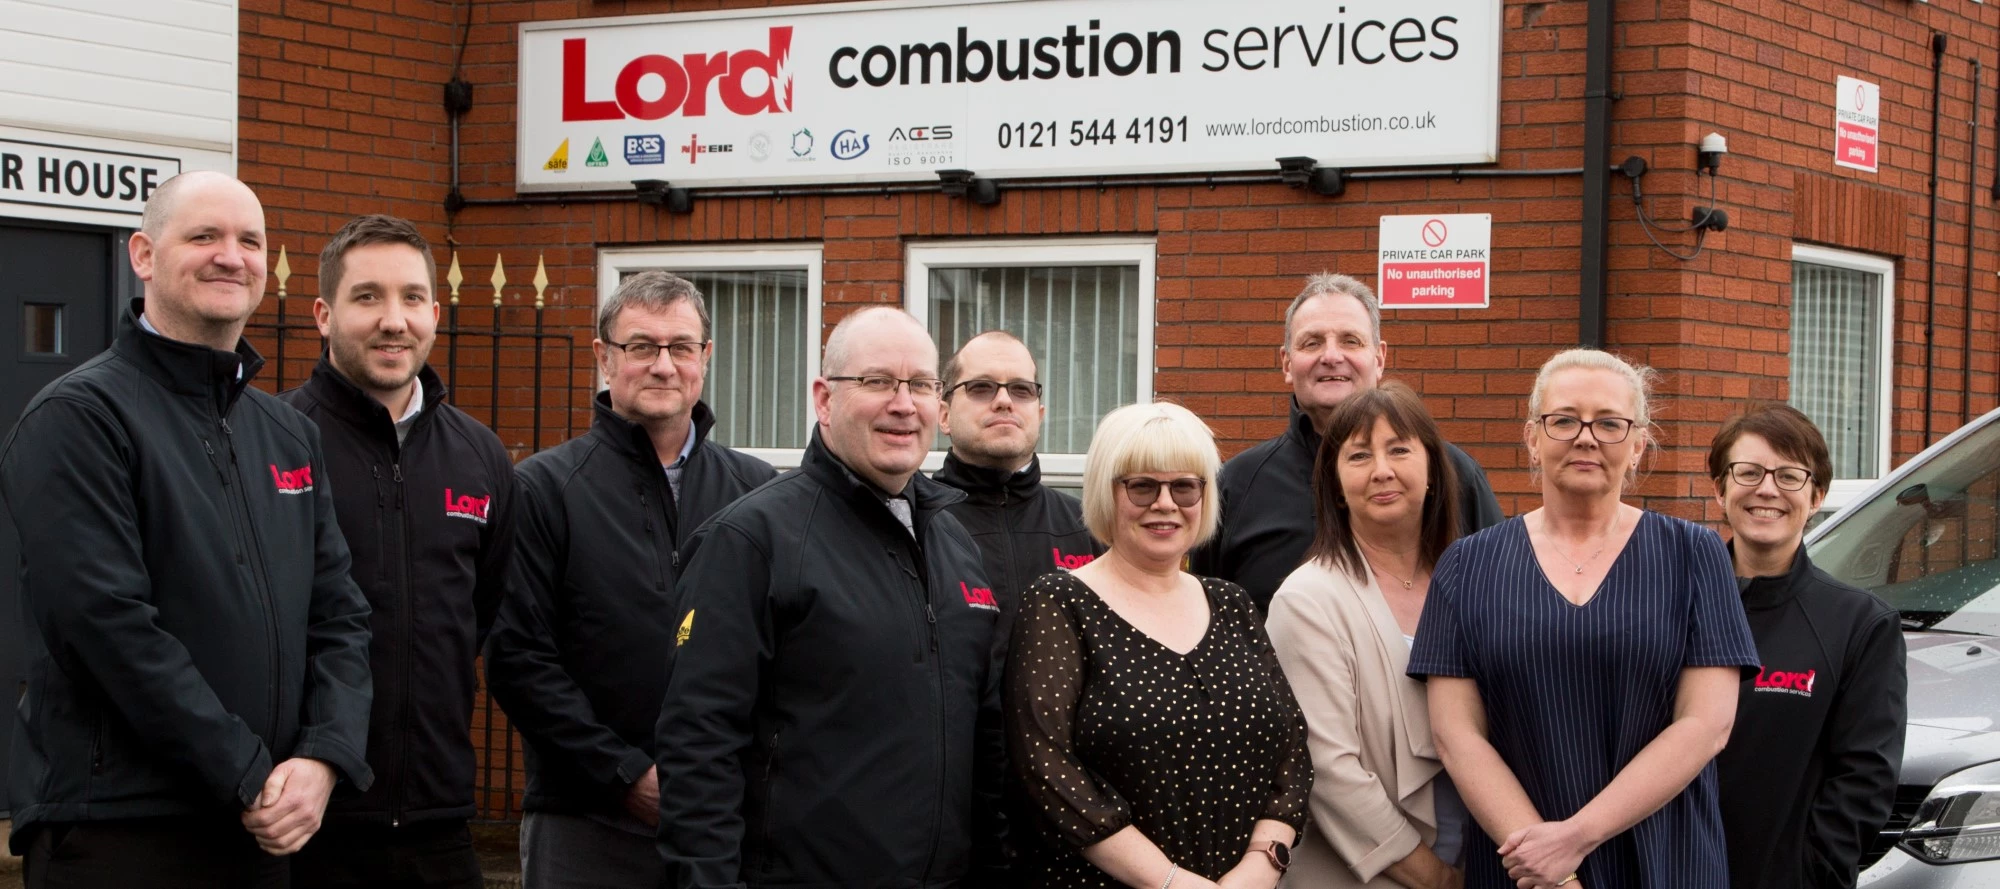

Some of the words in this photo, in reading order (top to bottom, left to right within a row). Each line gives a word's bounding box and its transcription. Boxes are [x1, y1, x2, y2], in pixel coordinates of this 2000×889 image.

[562, 26, 793, 122] Lord
[829, 19, 1181, 88] combustion
[1202, 6, 1459, 72] services
[888, 126, 953, 142] ACS
[998, 121, 1056, 149] 0121
[1070, 119, 1116, 147] 544
[1126, 115, 1187, 144] 4191
[1206, 111, 1436, 137] www.lordcombustion.co.uk
[627, 138, 661, 154] B&ES
[830, 129, 870, 160] CHAS
[888, 157, 911, 165] ISO
[920, 155, 953, 164] 9001
[2, 153, 24, 190] R
[38, 157, 157, 202] HOUSE
[1382, 250, 1427, 260] PRIVATE
[1430, 249, 1453, 260] CAR
[1456, 249, 1486, 259] PARK
[1387, 269, 1403, 280] No
[1406, 267, 1481, 280] unauthorised
[1412, 285, 1455, 298] parking
[445, 488, 490, 519] Lord
[960, 581, 998, 607] Lor
[1755, 665, 1815, 692] Lord
